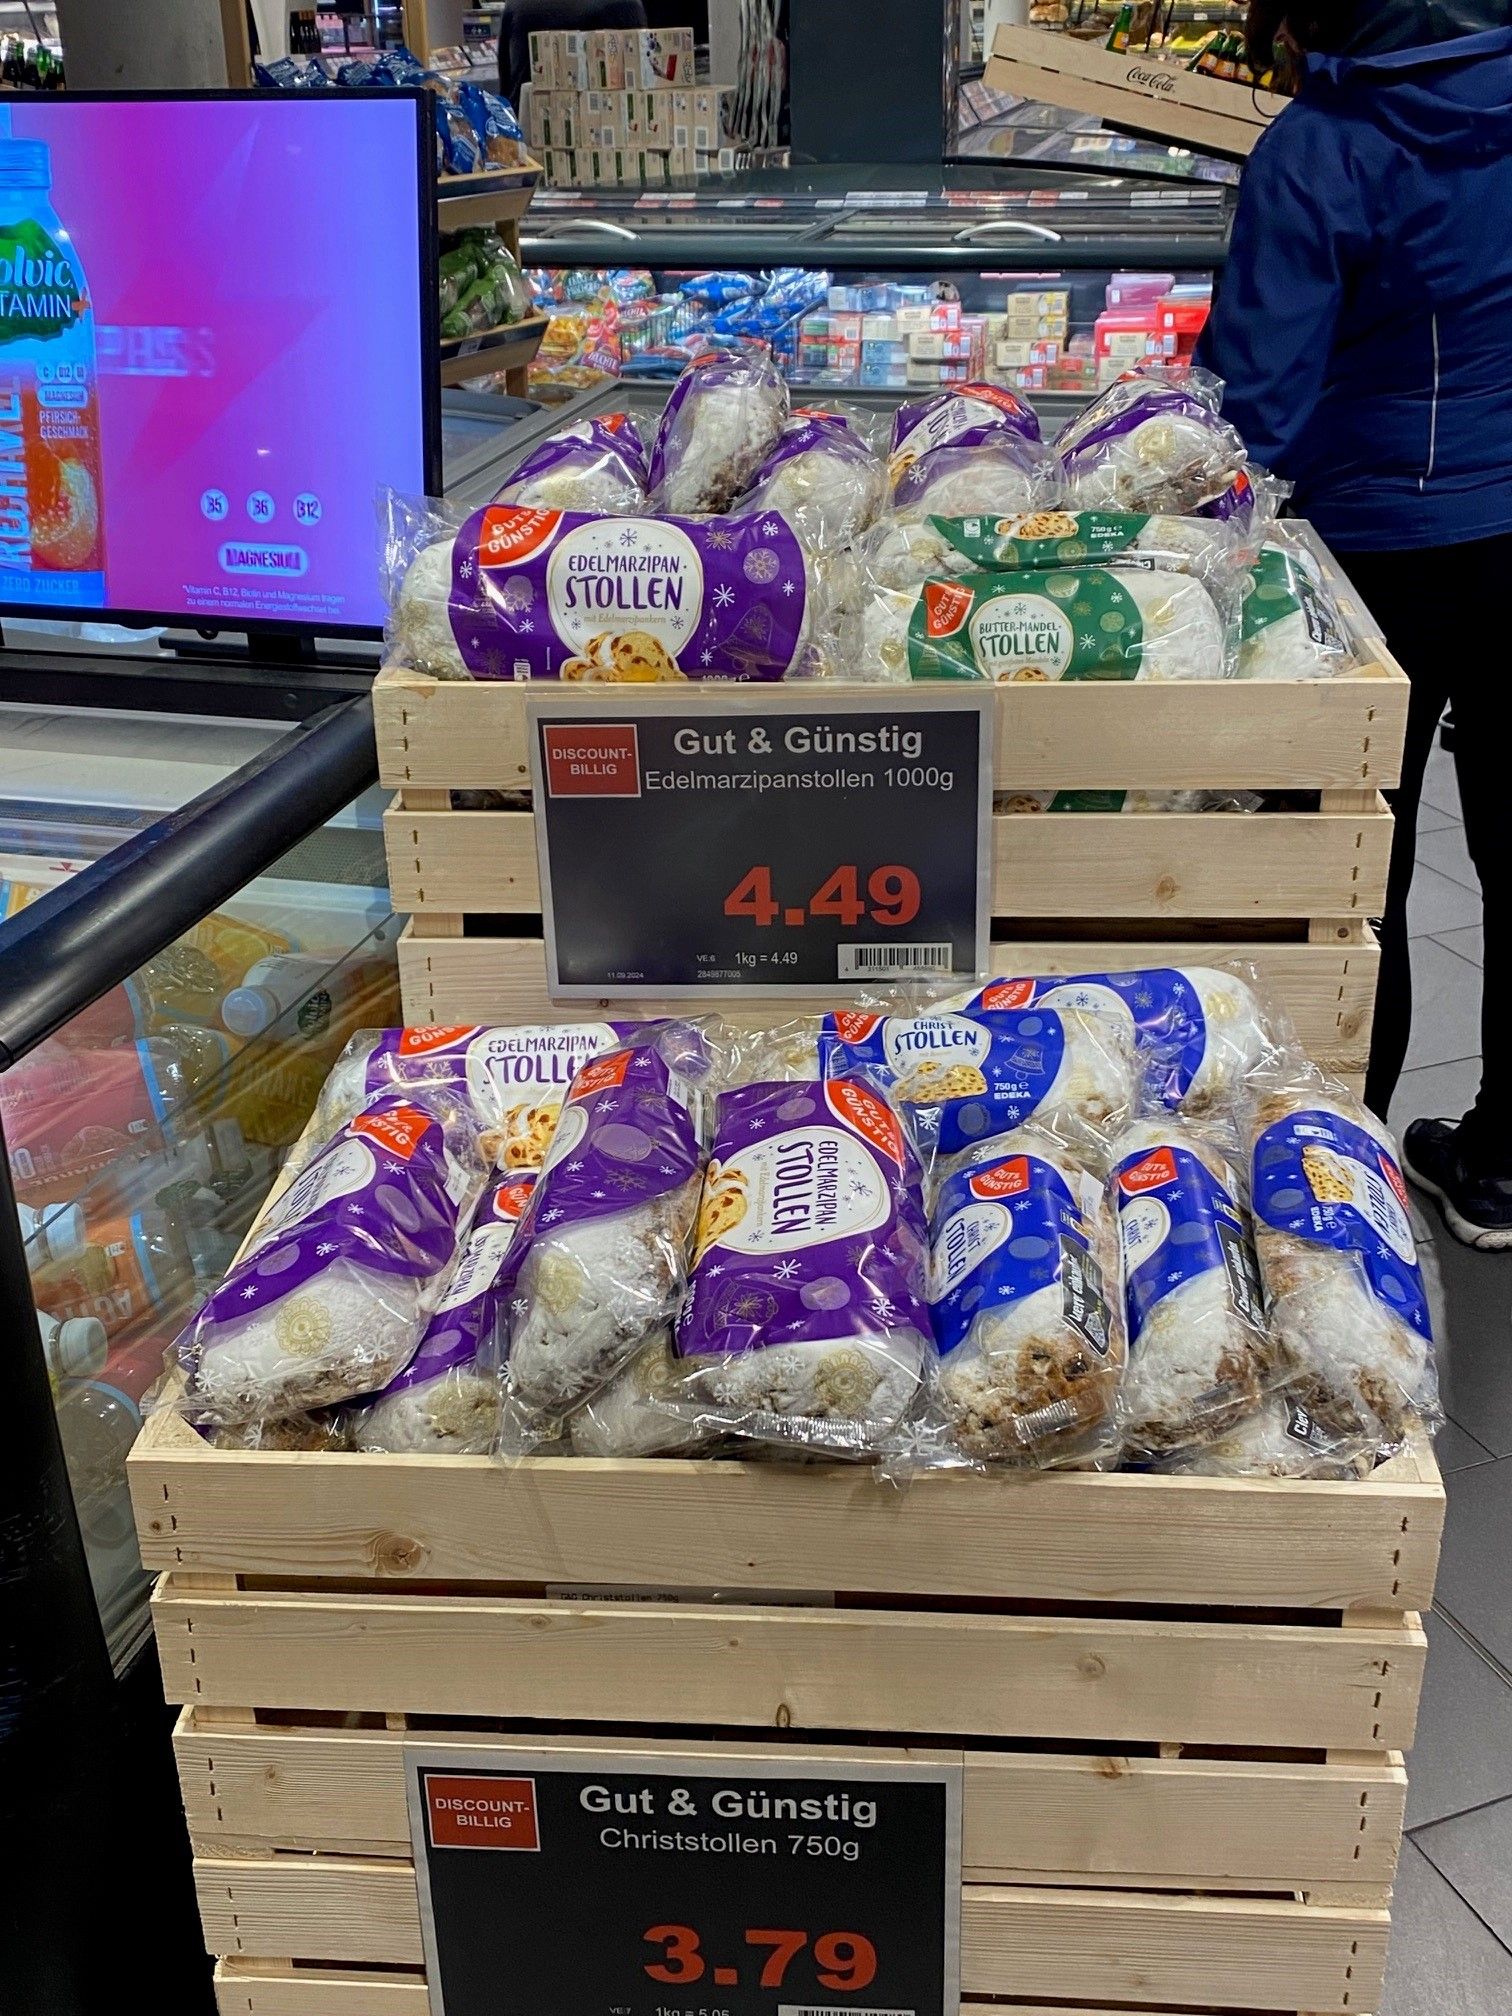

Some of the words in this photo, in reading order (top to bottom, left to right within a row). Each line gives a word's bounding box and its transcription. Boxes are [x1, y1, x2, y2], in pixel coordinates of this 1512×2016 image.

[296, 499, 320, 519] B12
[487, 507, 550, 555] GÜNSTIG
[226, 548, 301, 570] MAGNESIUM
[568, 554, 680, 573] EDELMARZIPAN
[35, 578, 80, 596] ZUCKER
[564, 575, 683, 611] STOLLEN
[978, 631, 1060, 658] STOLLEN
[552, 746, 633, 762] DISCOUNT-
[673, 728, 737, 756] Gut
[747, 727, 773, 754] &
[784, 724, 924, 760] Günstig
[569, 762, 618, 776] BILLIG
[645, 768, 876, 794] Edelmarzipanstollen
[883, 766, 955, 791] 1000g
[723, 863, 922, 928] 4.49
[734, 952, 757, 967] 1kg
[770, 952, 798, 966] 4.49
[488, 1035, 599, 1053] EDELMARZIPAN
[894, 1030, 977, 1055] STOLLEN
[993, 1091, 1032, 1101] EDEKA
[994, 1082, 1018, 1093] 750g
[841, 1087, 899, 1154] GÜNSTIG
[770, 1141, 814, 1235] STOLLEN
[814, 1140, 839, 1226] EDELMARZIPAN
[980, 1174, 1022, 1191] GÜNSTIG
[1310, 1206, 1325, 1233] EDEKA
[966, 1220, 982, 1254] CHRIST
[945, 1217, 967, 1285] STOLLEN
[581, 1592, 652, 1602] Christstollen
[656, 1593, 680, 1603] 750g
[434, 1797, 530, 1815] DISCOUNT-
[579, 1784, 655, 1816] Gut
[667, 1788, 698, 1818] &
[711, 1790, 878, 1829] Günstig
[456, 1813, 513, 1830] BILLIG
[599, 1827, 777, 1855] Christstollen
[787, 1834, 860, 1862] 750g
[642, 1922, 878, 1992] 3.79
